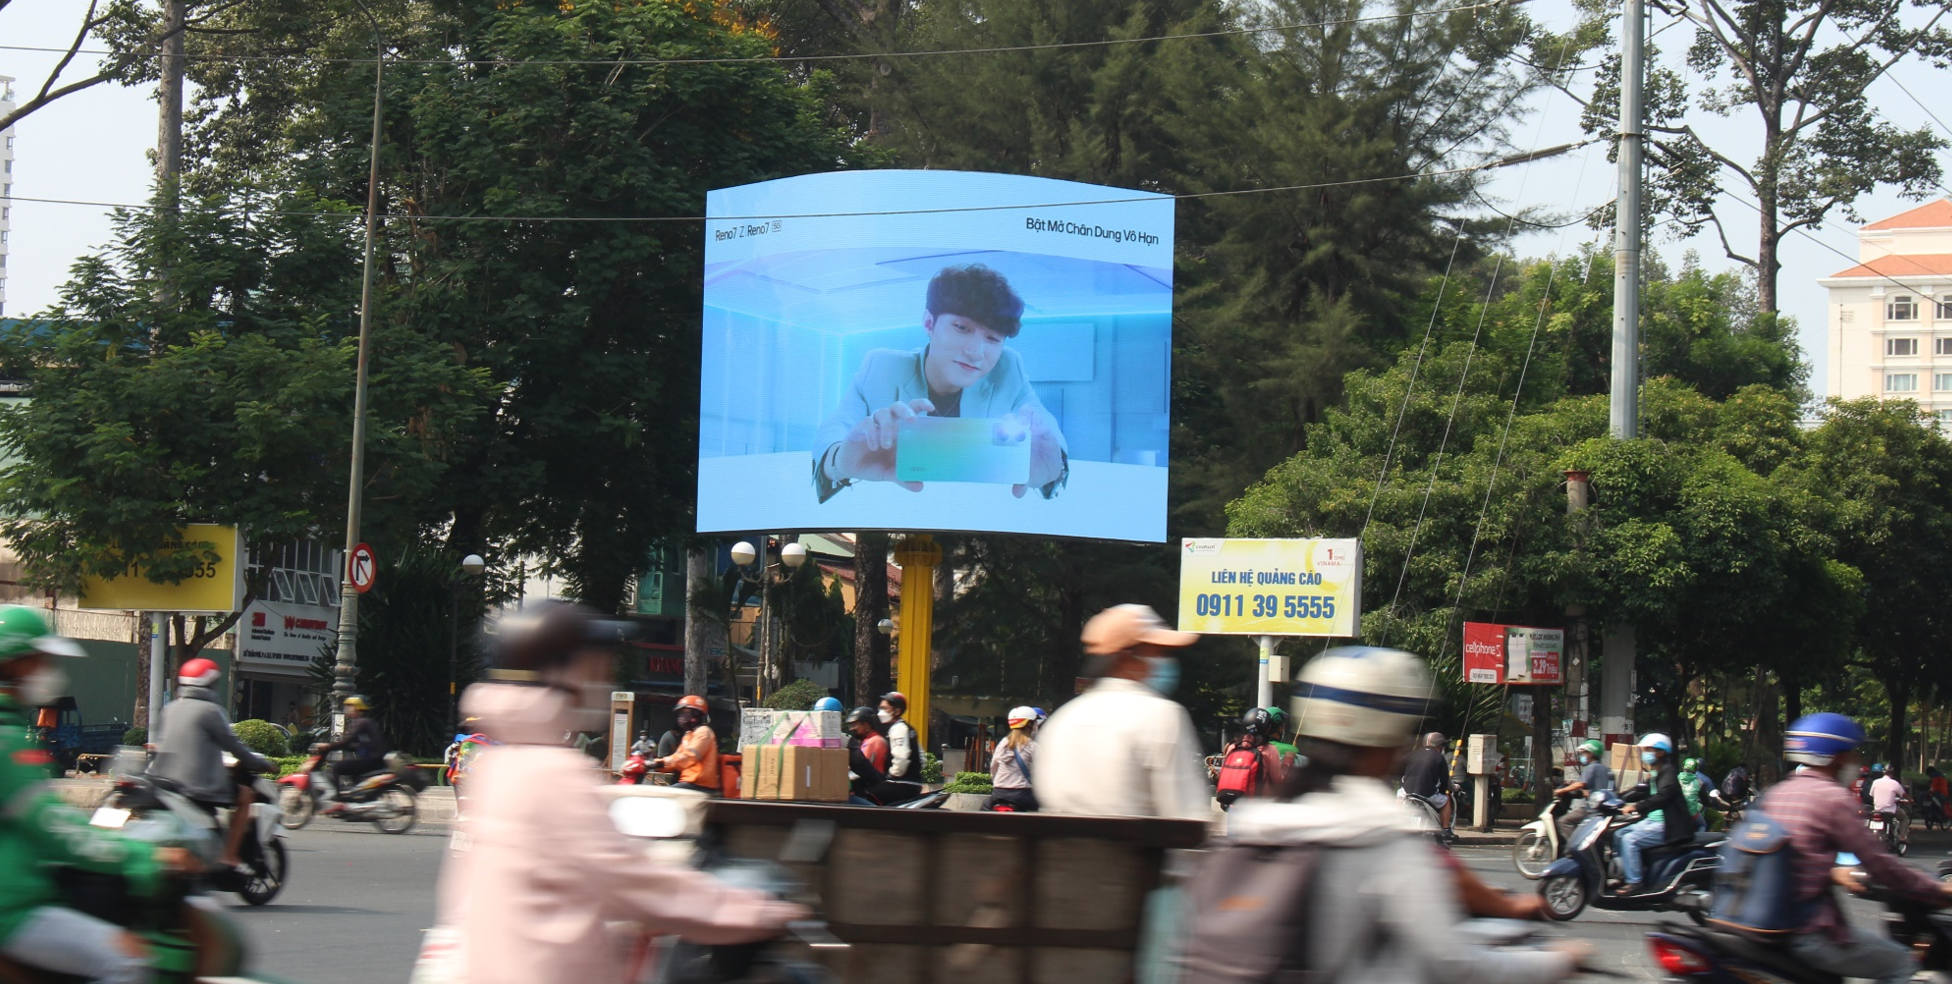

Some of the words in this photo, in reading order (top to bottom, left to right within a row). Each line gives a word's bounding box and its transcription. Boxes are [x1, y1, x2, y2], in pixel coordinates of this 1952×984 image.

[716, 227, 737, 241] Reno7
[739, 225, 744, 238] Z
[747, 222, 770, 236] Reno7
[773, 221, 781, 232] 5G
[1026, 217, 1046, 233] Bật
[1048, 219, 1064, 233] Mở
[1066, 222, 1093, 237] Chân
[1095, 225, 1122, 243] Dung
[1123, 229, 1137, 242] Vô
[1139, 231, 1159, 247] Hạn
[1327, 548, 1333, 560] 1
[1211, 568, 1236, 584] LIÊN
[1239, 568, 1254, 587] HỆ
[1257, 567, 1296, 586] QUẢNG
[1298, 569, 1323, 586] CÁO
[1196, 593, 1244, 617] 0911
[1252, 594, 1278, 618] 39
[1283, 595, 1336, 619] 5555
